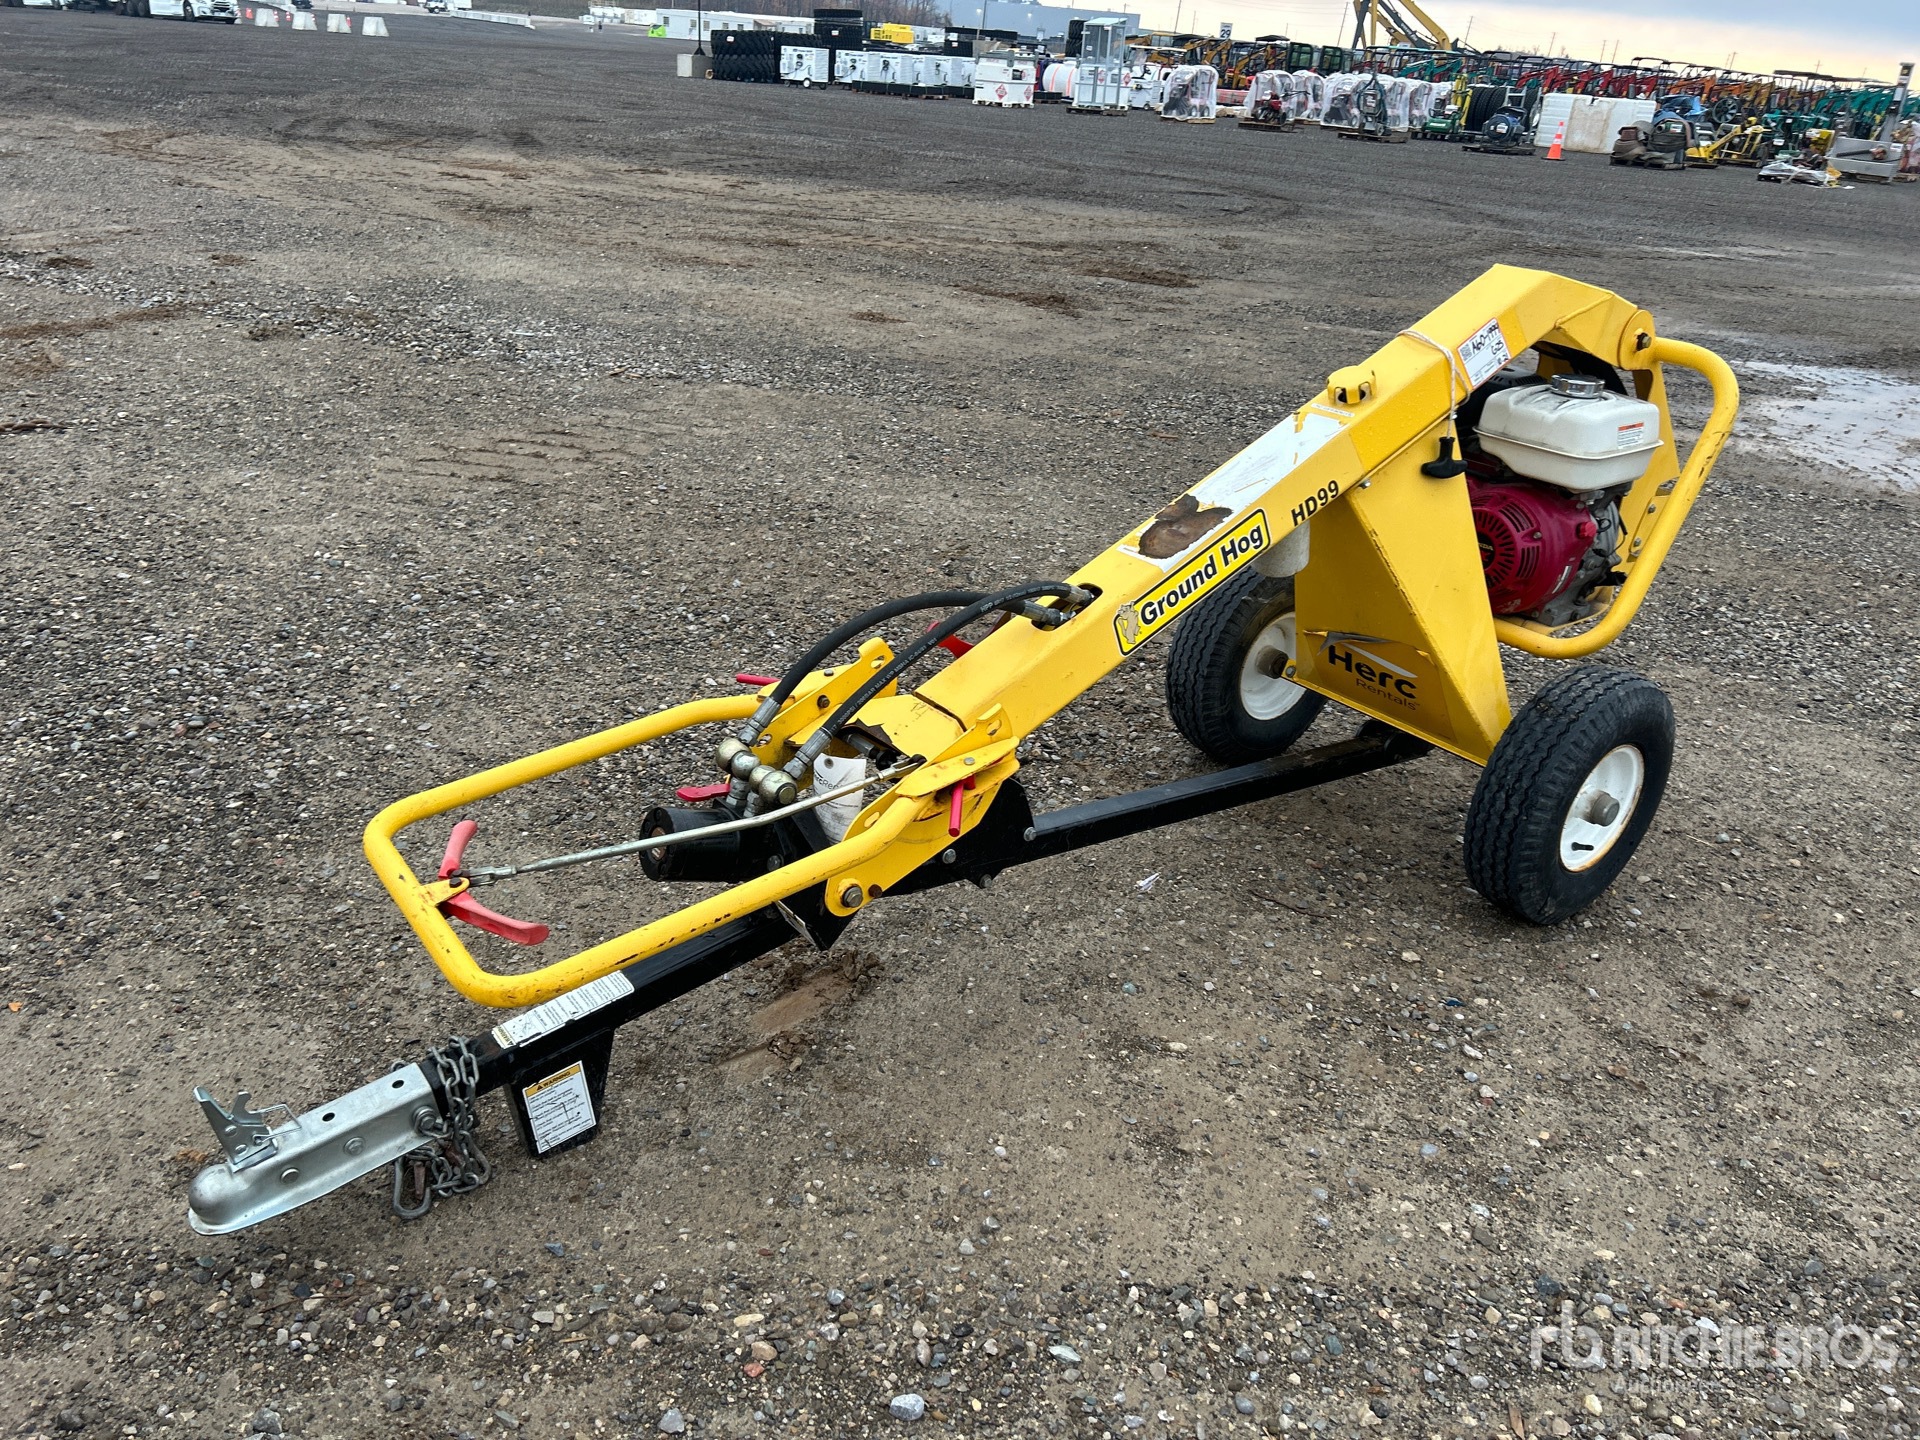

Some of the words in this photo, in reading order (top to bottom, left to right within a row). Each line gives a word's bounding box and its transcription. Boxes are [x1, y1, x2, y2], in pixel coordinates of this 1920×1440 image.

[1220, 29, 1231, 38] 29
[1291, 480, 1339, 526] HD99
[1140, 553, 1217, 625] Ground
[1221, 525, 1263, 567] Hog
[875, 679, 887, 689] MAX
[1329, 645, 1417, 699] Herc
[1356, 678, 1418, 711] Rentals
[543, 1071, 571, 1087] WARNING
